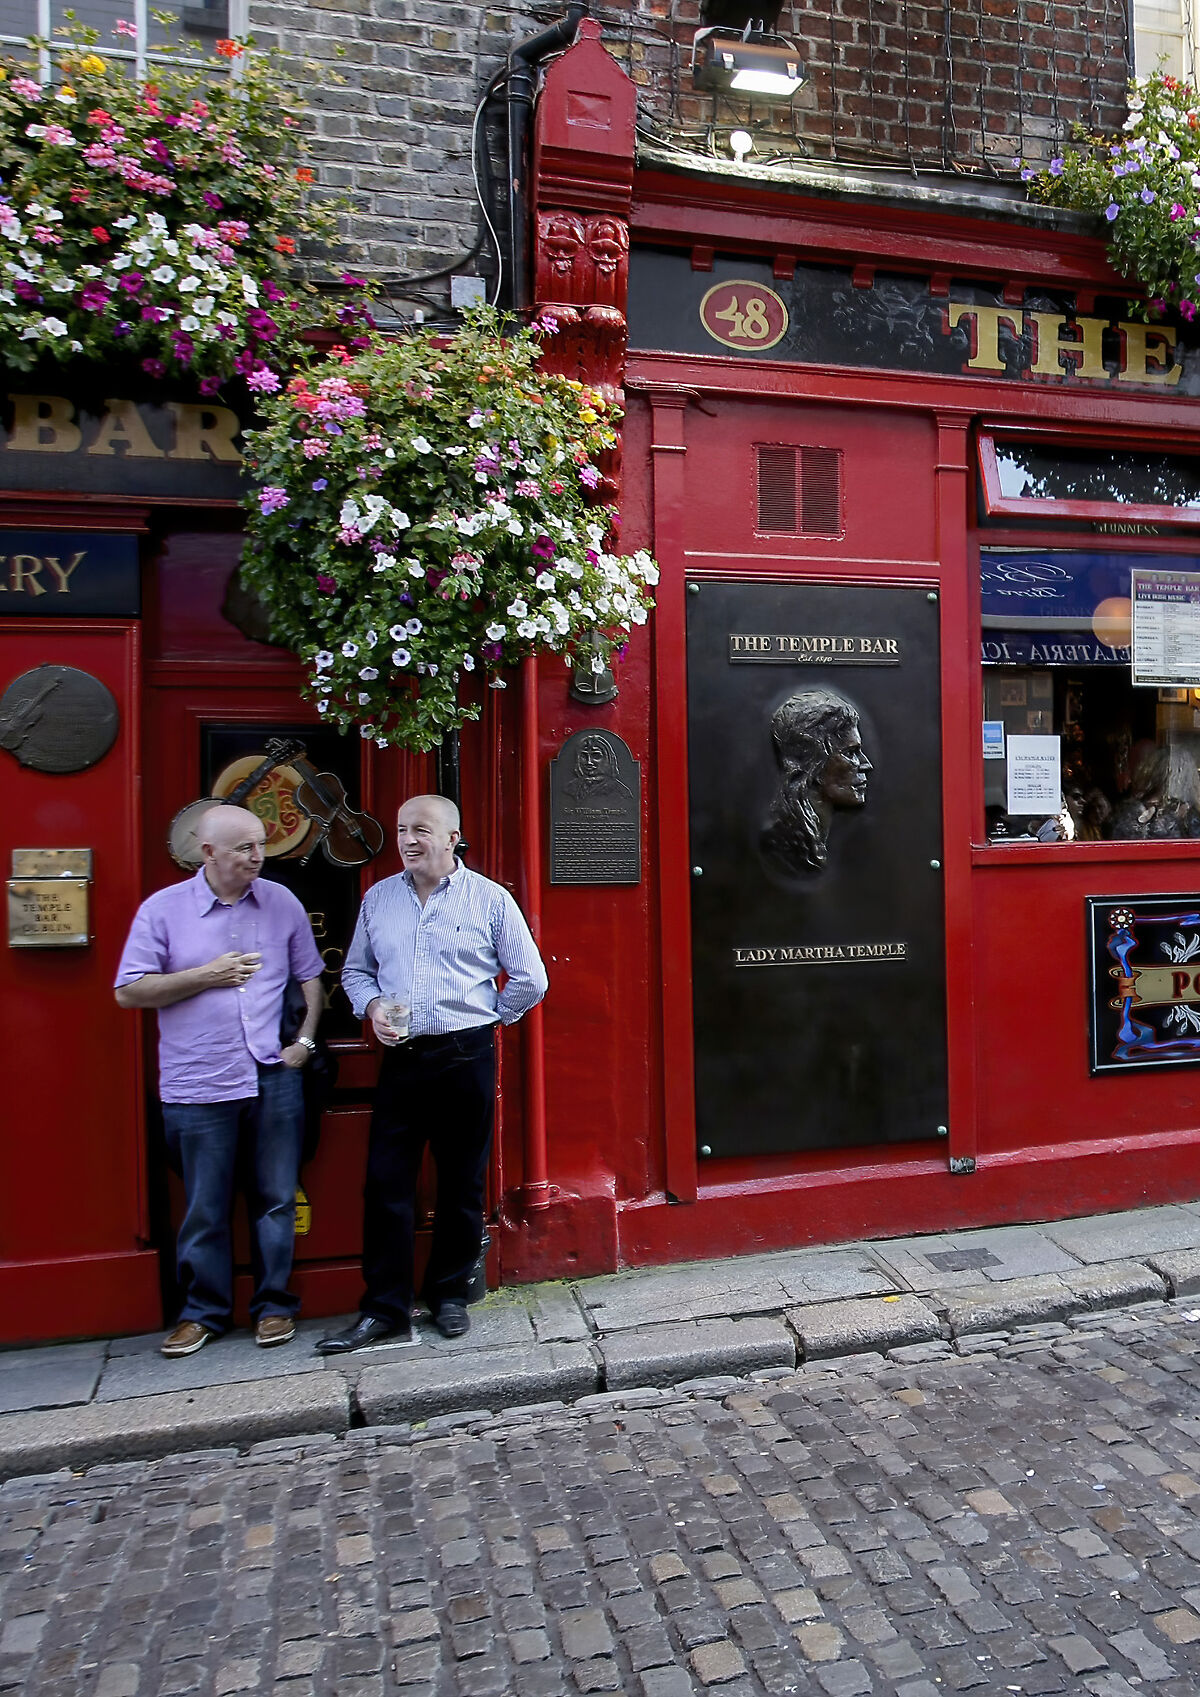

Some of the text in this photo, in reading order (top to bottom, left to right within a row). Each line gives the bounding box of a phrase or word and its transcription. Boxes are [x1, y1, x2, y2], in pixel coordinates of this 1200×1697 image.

[715, 295, 770, 340] 48
[945, 303, 1184, 386] THE
[7, 393, 245, 463] BAR
[1156, 584, 1183, 592] TEMPLE
[731, 636, 899, 655] THE TEMPLE BAR
[797, 653, 814, 663] Est.
[36, 893, 59, 902] THE
[23, 903, 72, 912] TEMPLE
[35, 913, 58, 922] BAR
[735, 943, 907, 962] LADY MARTHA TEMPLE
